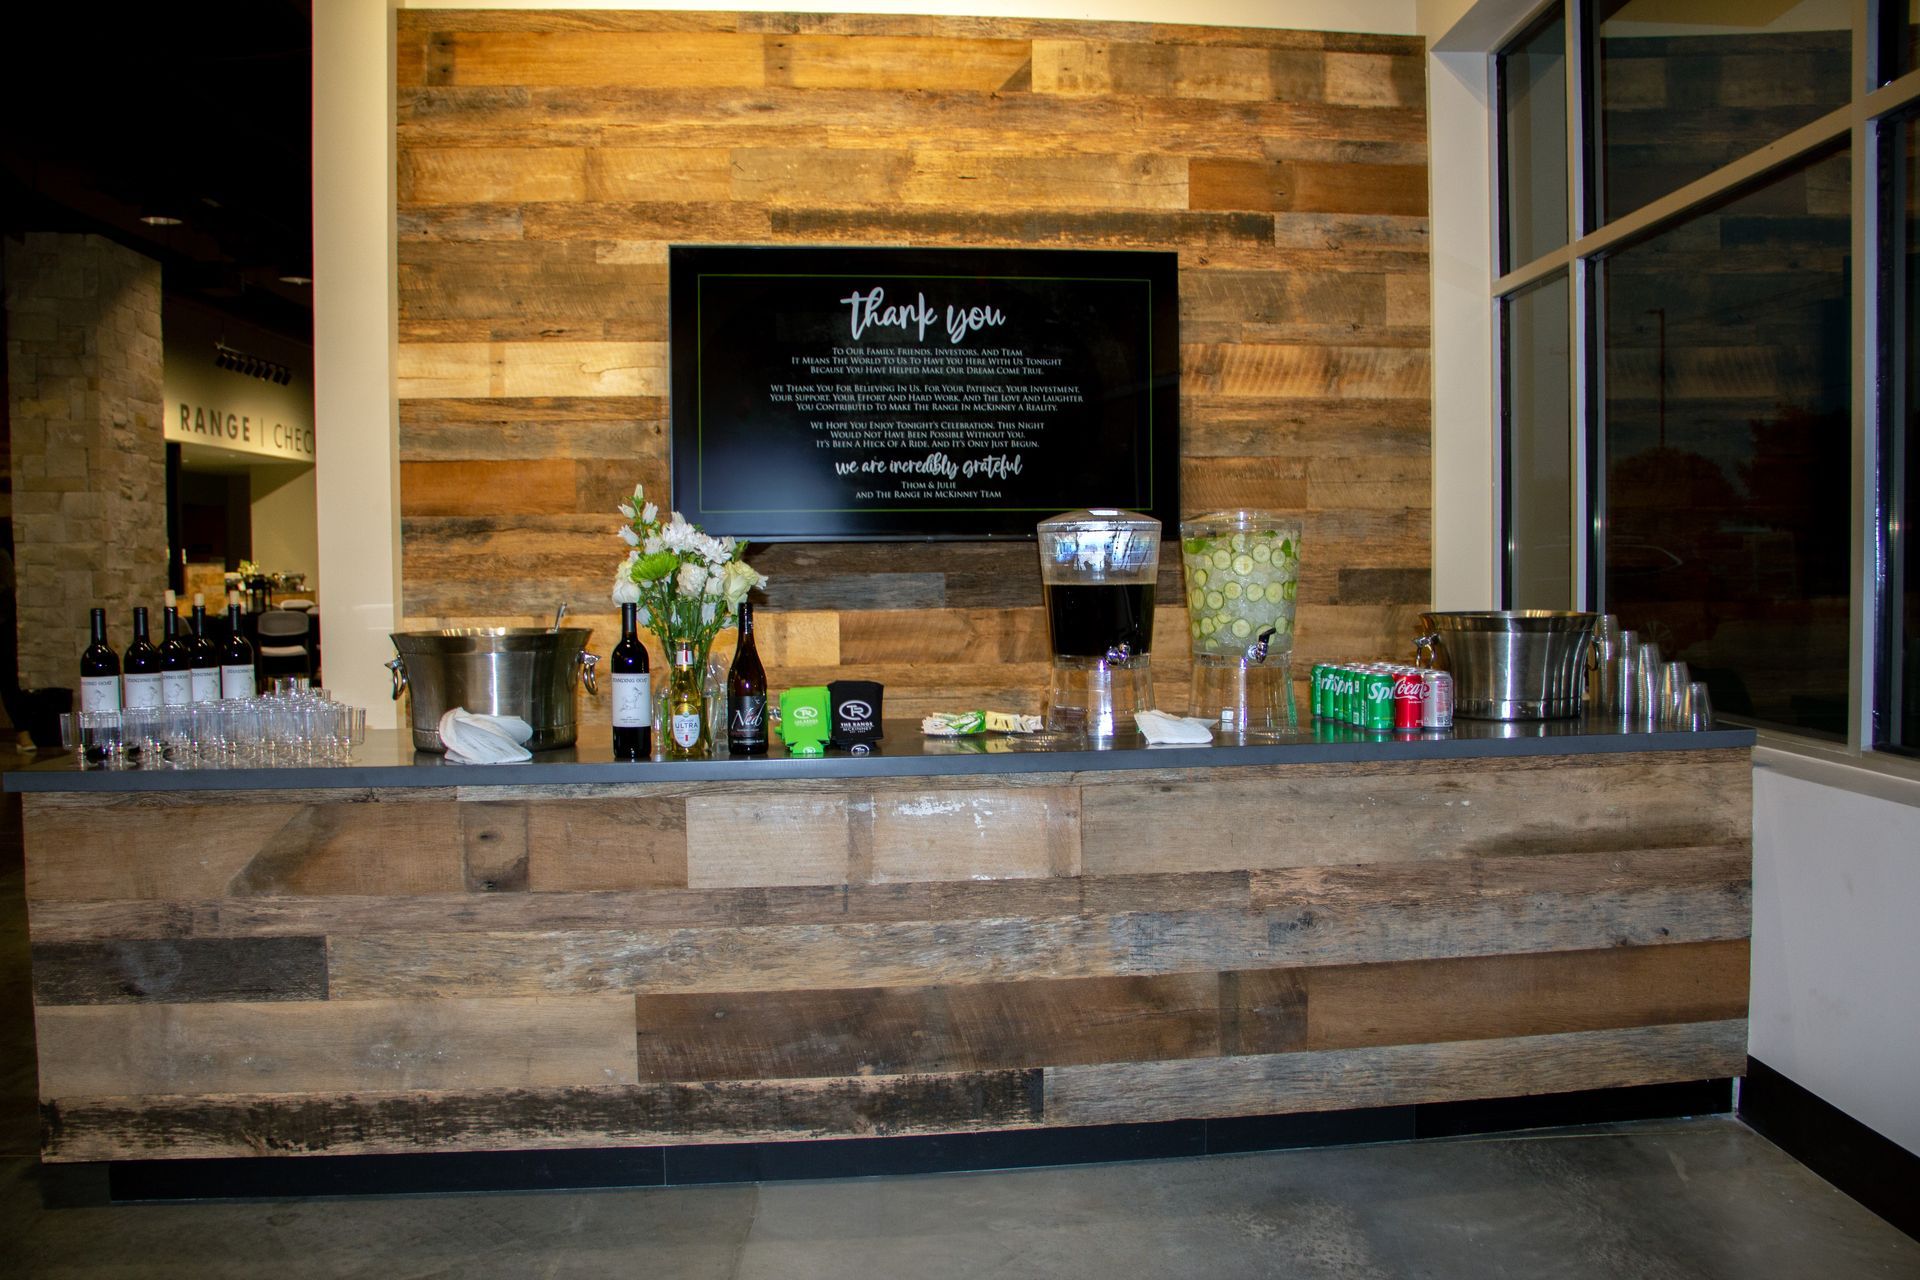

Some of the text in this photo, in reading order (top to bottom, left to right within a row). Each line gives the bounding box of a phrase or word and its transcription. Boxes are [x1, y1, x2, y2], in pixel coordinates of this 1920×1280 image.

[840, 286, 1006, 344] thank you
[180, 403, 313, 454] RANGE CHEC
[835, 451, 1023, 480] we are incredibly grateful
